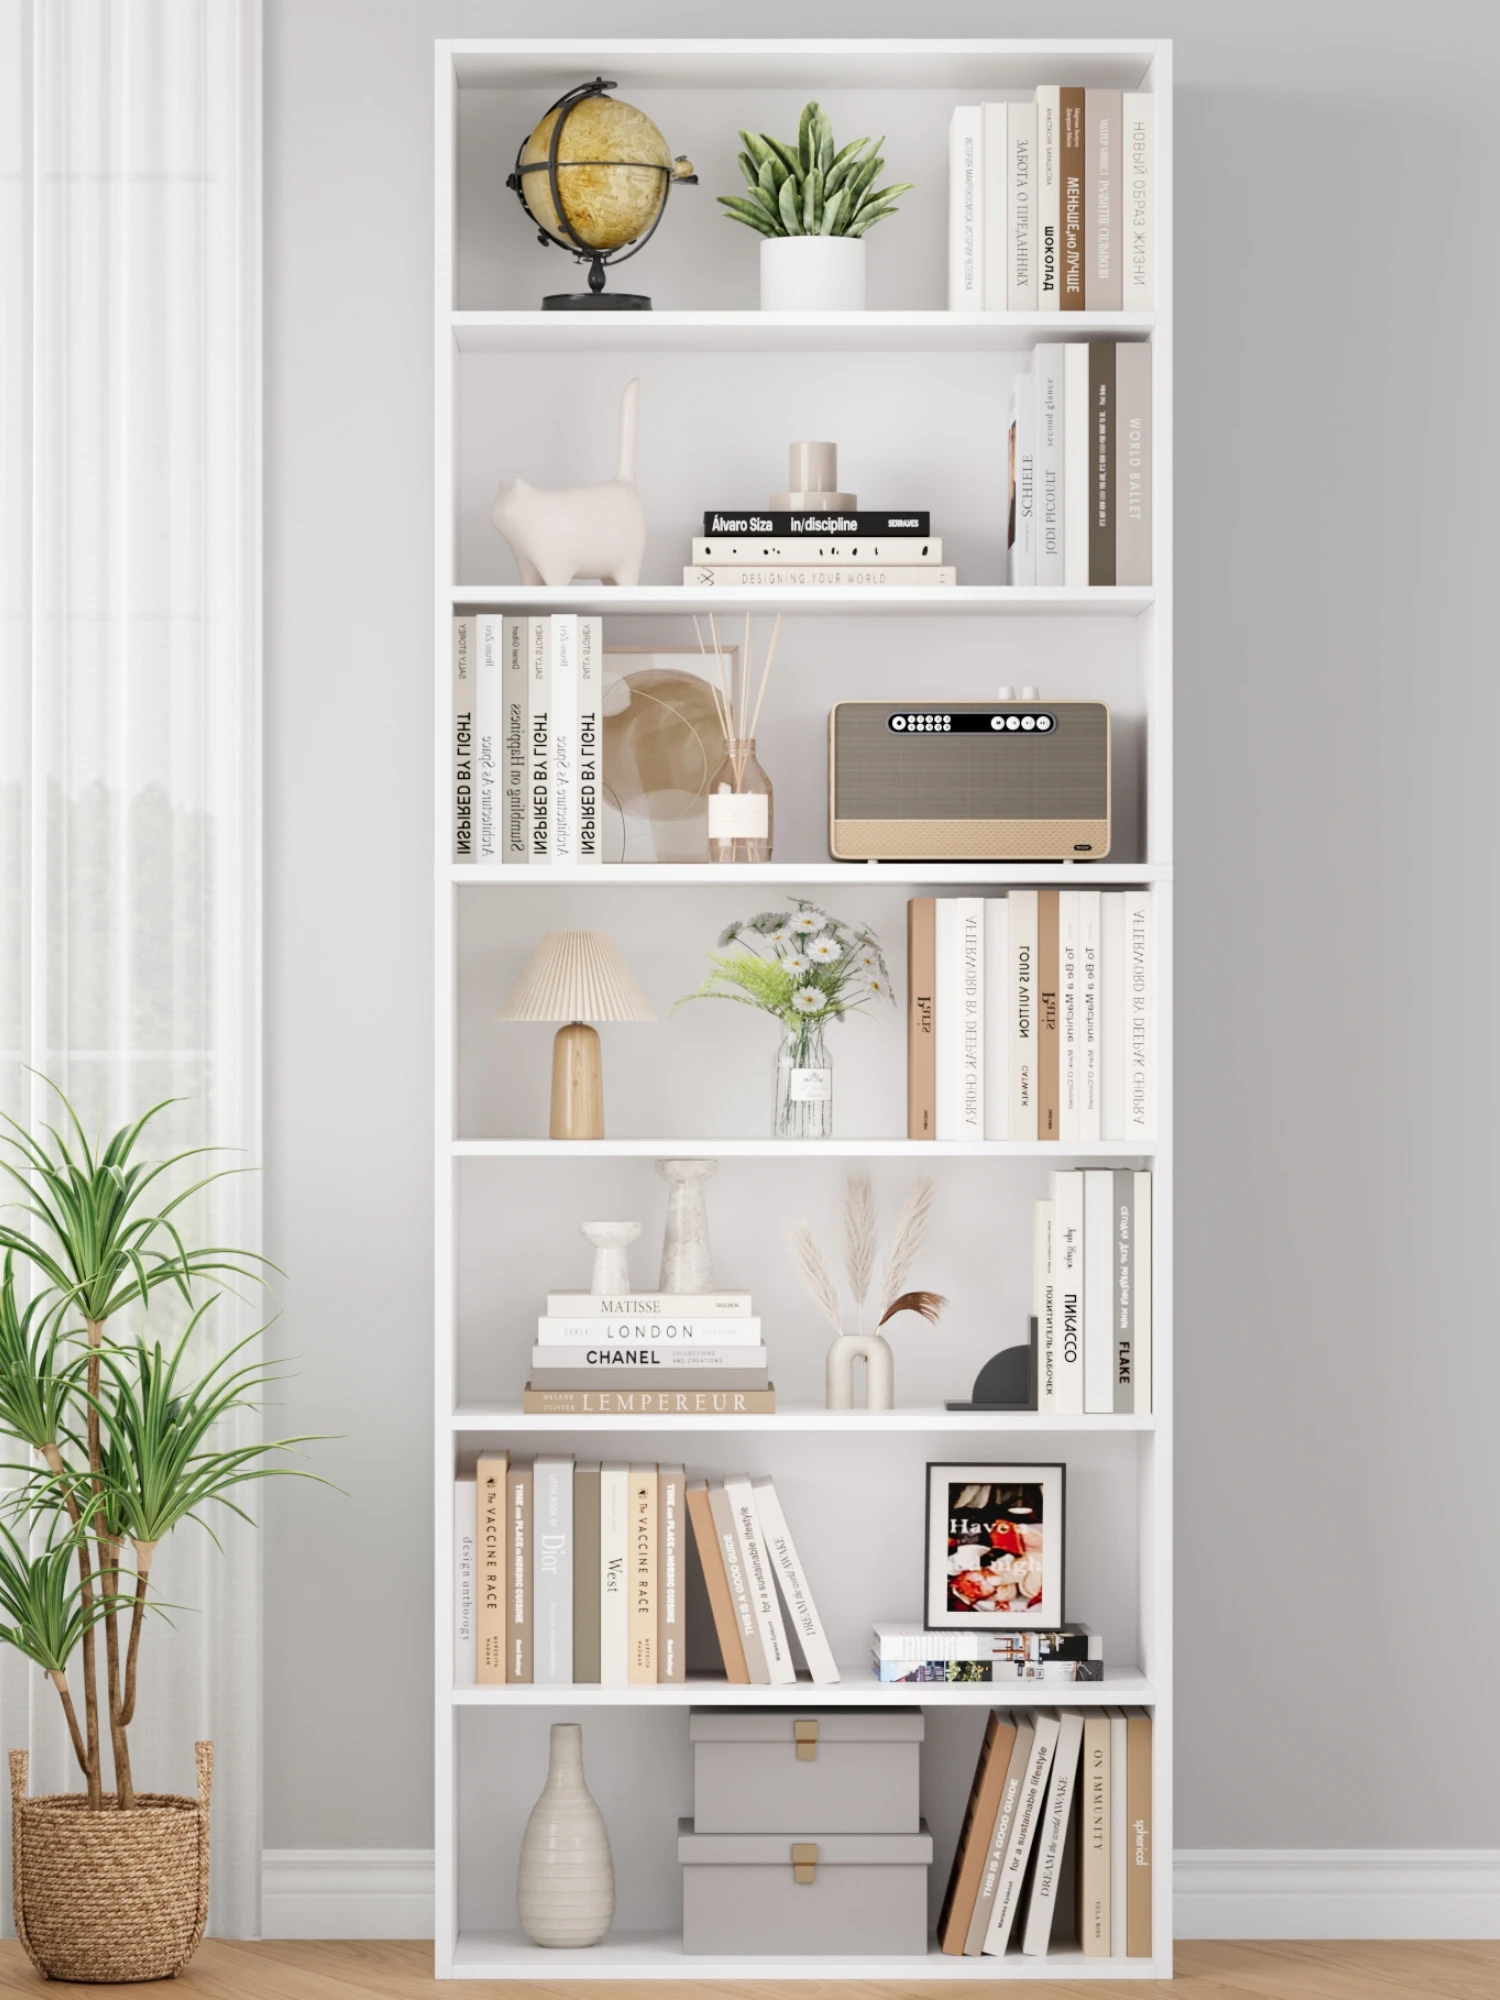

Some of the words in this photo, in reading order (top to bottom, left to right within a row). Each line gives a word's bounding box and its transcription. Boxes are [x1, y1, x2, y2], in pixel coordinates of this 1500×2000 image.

[1016, 139, 1028, 187] ЗАБОТА
[1133, 121, 1148, 175] НОВЫЙ
[1016, 192, 1028, 202] О
[1133, 180, 1145, 227] ОБРАЗ
[1016, 205, 1028, 287] ПРЕДАННЫХ
[1043, 226, 1054, 291] ШОКОЛАД
[1133, 231, 1145, 286] ЖИЗНИ
[1066, 250, 1079, 293] ЛУЧШЕ
[1044, 378, 1056, 410] glance
[1044, 414, 1056, 447] second
[1129, 417, 1141, 467] WORLD
[1022, 455, 1033, 517] SCHIELE
[1045, 469, 1057, 523] PICOULT
[1129, 473, 1141, 520] BALLET
[712, 514, 748, 531] Álvaro
[749, 517, 773, 531] Siza
[790, 517, 858, 534] in/discipline
[1045, 527, 1057, 555] JODI
[742, 573, 805, 584] DESIGNING
[811, 573, 843, 584] YOUR
[847, 573, 886, 584] WORLD
[601, 1300, 661, 1313] MATISSE
[1045, 1285, 1054, 1349] ПОХИТИТЕЛЬ
[607, 1325, 693, 1339] LONDON
[1064, 1294, 1077, 1363] ПИКАССО
[586, 1350, 660, 1365] CHANEL
[1045, 1351, 1054, 1395] БАБОЧЕК
[1119, 1342, 1130, 1384] FLAKE
[583, 1394, 747, 1412] LEMPEREUR
[486, 1492, 497, 1505] The
[514, 1484, 524, 1507] TIME
[638, 1502, 648, 1515] The
[666, 1484, 675, 1507] TIME
[486, 1508, 497, 1567] VACCINE
[514, 1520, 524, 1548] PLACE
[666, 1520, 675, 1548] PLACE
[739, 1507, 756, 1540] lifestyle
[460, 1537, 474, 1578] design
[540, 1533, 567, 1575] Dior
[638, 1518, 648, 1575] VACCINE
[723, 1533, 738, 1563] GUIDE
[773, 1536, 795, 1570] AWAKE
[514, 1555, 524, 1588] NORDIC
[607, 1558, 623, 1593] West
[666, 1555, 675, 1588] NORDIC
[731, 1565, 744, 1594] GOOD
[745, 1542, 767, 1591] sustainable
[486, 1574, 497, 1610] RACE
[514, 1589, 524, 1623] CUISINE
[638, 1580, 648, 1614] RACE
[666, 1589, 675, 1623] CUISINE
[738, 1594, 747, 1602] A
[739, 1603, 749, 1613] IS
[760, 1601, 771, 1613] for
[742, 1614, 755, 1636] THIS
[795, 1599, 816, 1636] DREAM
[1093, 1749, 1103, 1768] ON
[1004, 1778, 1019, 1813] GUIDE
[1009, 1857, 1020, 1872] for
[1017, 1788, 1038, 1846] sustainable
[1030, 1746, 1048, 1786] lifestyle
[1053, 1775, 1068, 1817] AWAKE
[1050, 1817, 1061, 1841] world
[1093, 1776, 1103, 1851] IMMUNITY
[996, 1814, 1011, 1849] GOOD
[1047, 1841, 1058, 1853] the
[1133, 1820, 1149, 1866] spherical
[988, 1861, 999, 1872] IS
[993, 1851, 1001, 1859] A
[983, 1872, 996, 1898] THIS
[1039, 1854, 1056, 1897] DREAM
